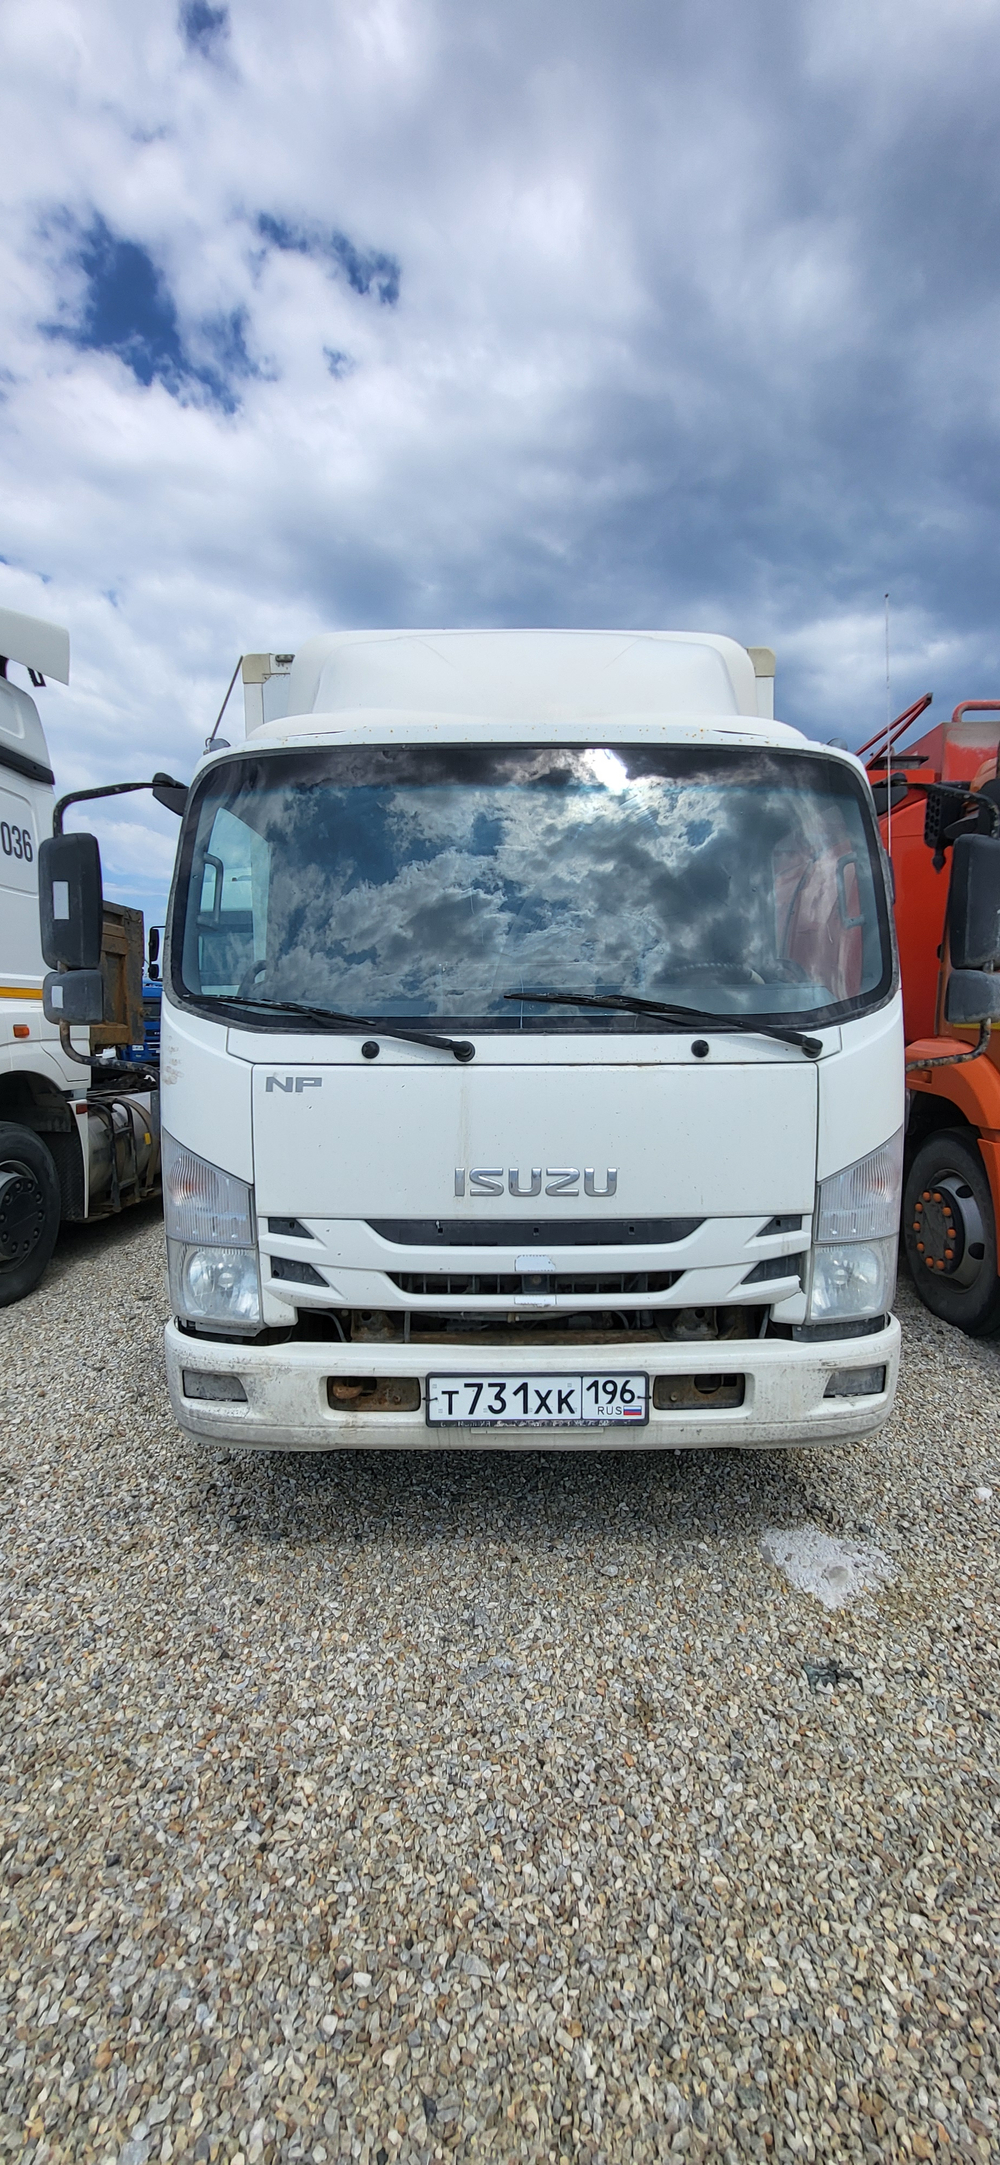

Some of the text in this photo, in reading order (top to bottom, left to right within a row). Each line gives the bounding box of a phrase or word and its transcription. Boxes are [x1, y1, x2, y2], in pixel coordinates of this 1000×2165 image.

[0, 821, 33, 863] 036
[265, 1076, 323, 1093] NP
[454, 1166, 618, 1197] ISUZU
[585, 1379, 636, 1405] 196
[597, 1406, 622, 1416] RUS
